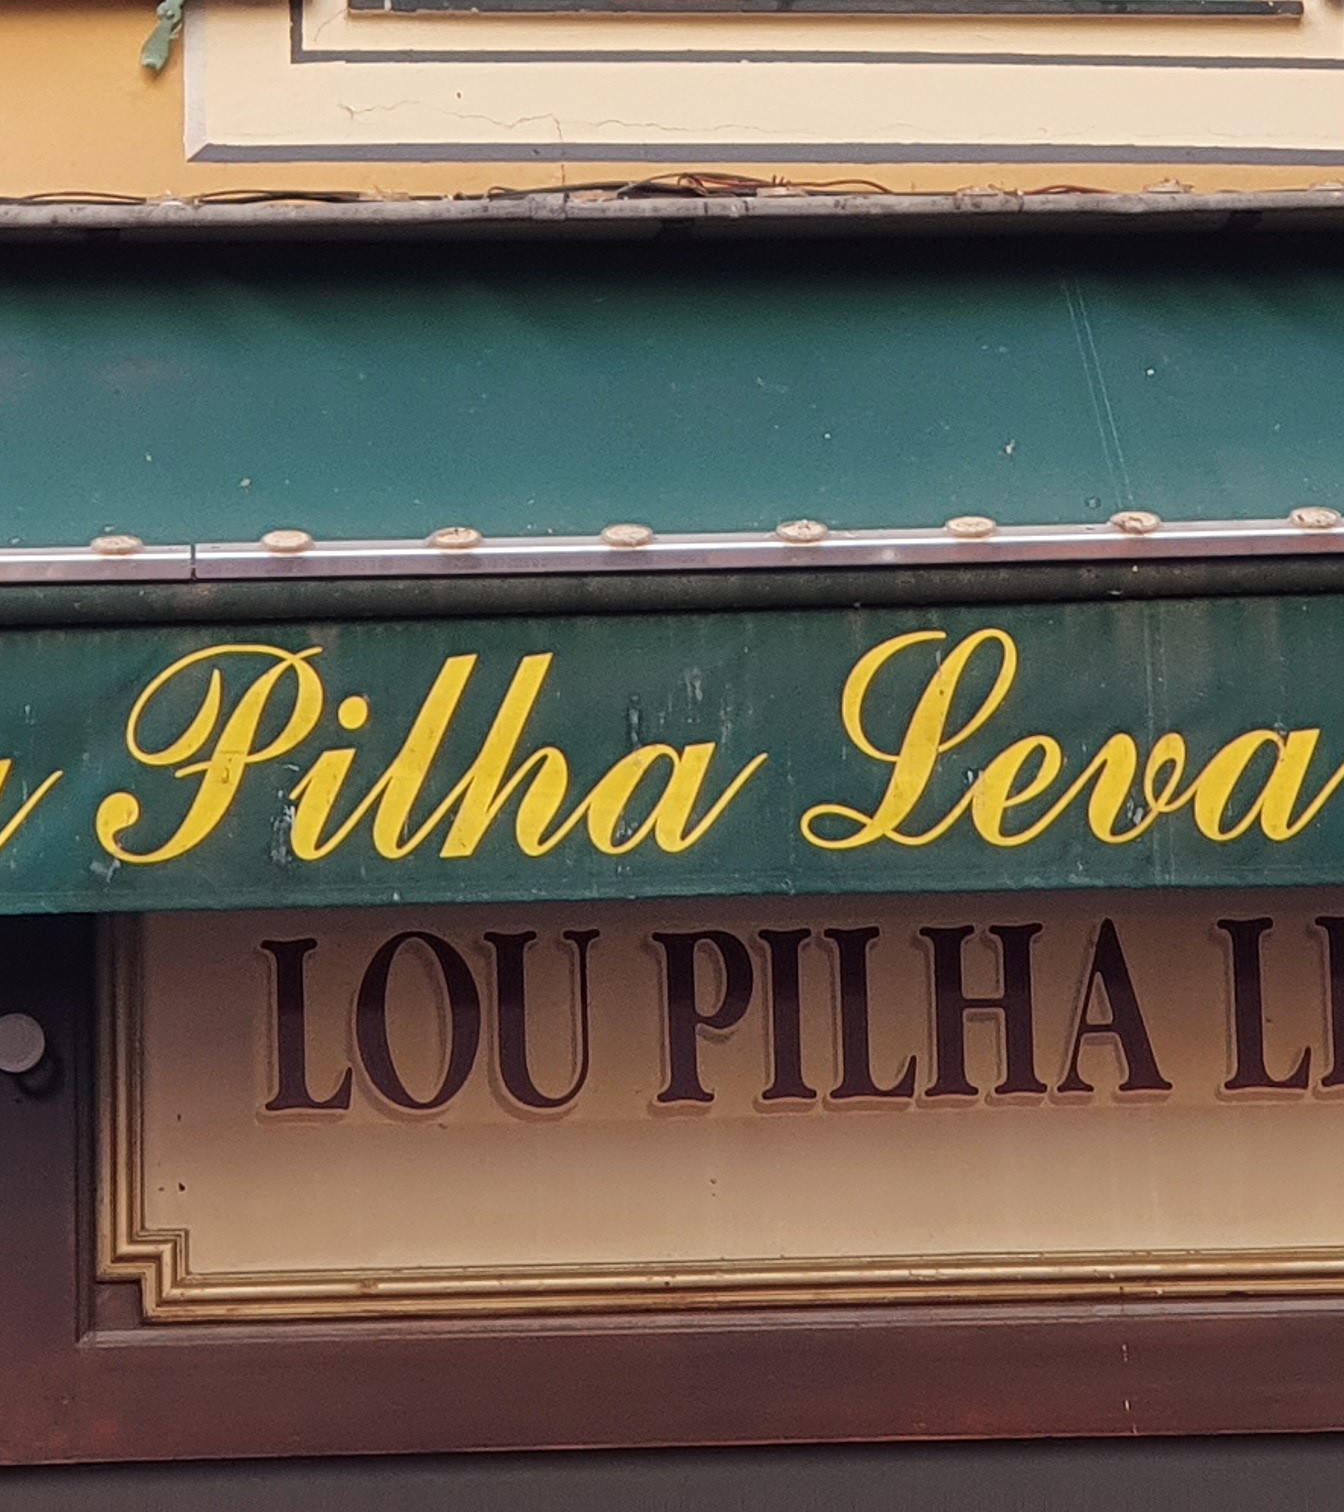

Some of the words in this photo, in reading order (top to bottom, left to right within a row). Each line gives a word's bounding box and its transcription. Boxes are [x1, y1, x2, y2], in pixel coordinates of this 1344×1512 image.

[97, 642, 767, 864] Pilha
[261, 925, 601, 1115] LOU
[652, 917, 1175, 1108] PILHA
